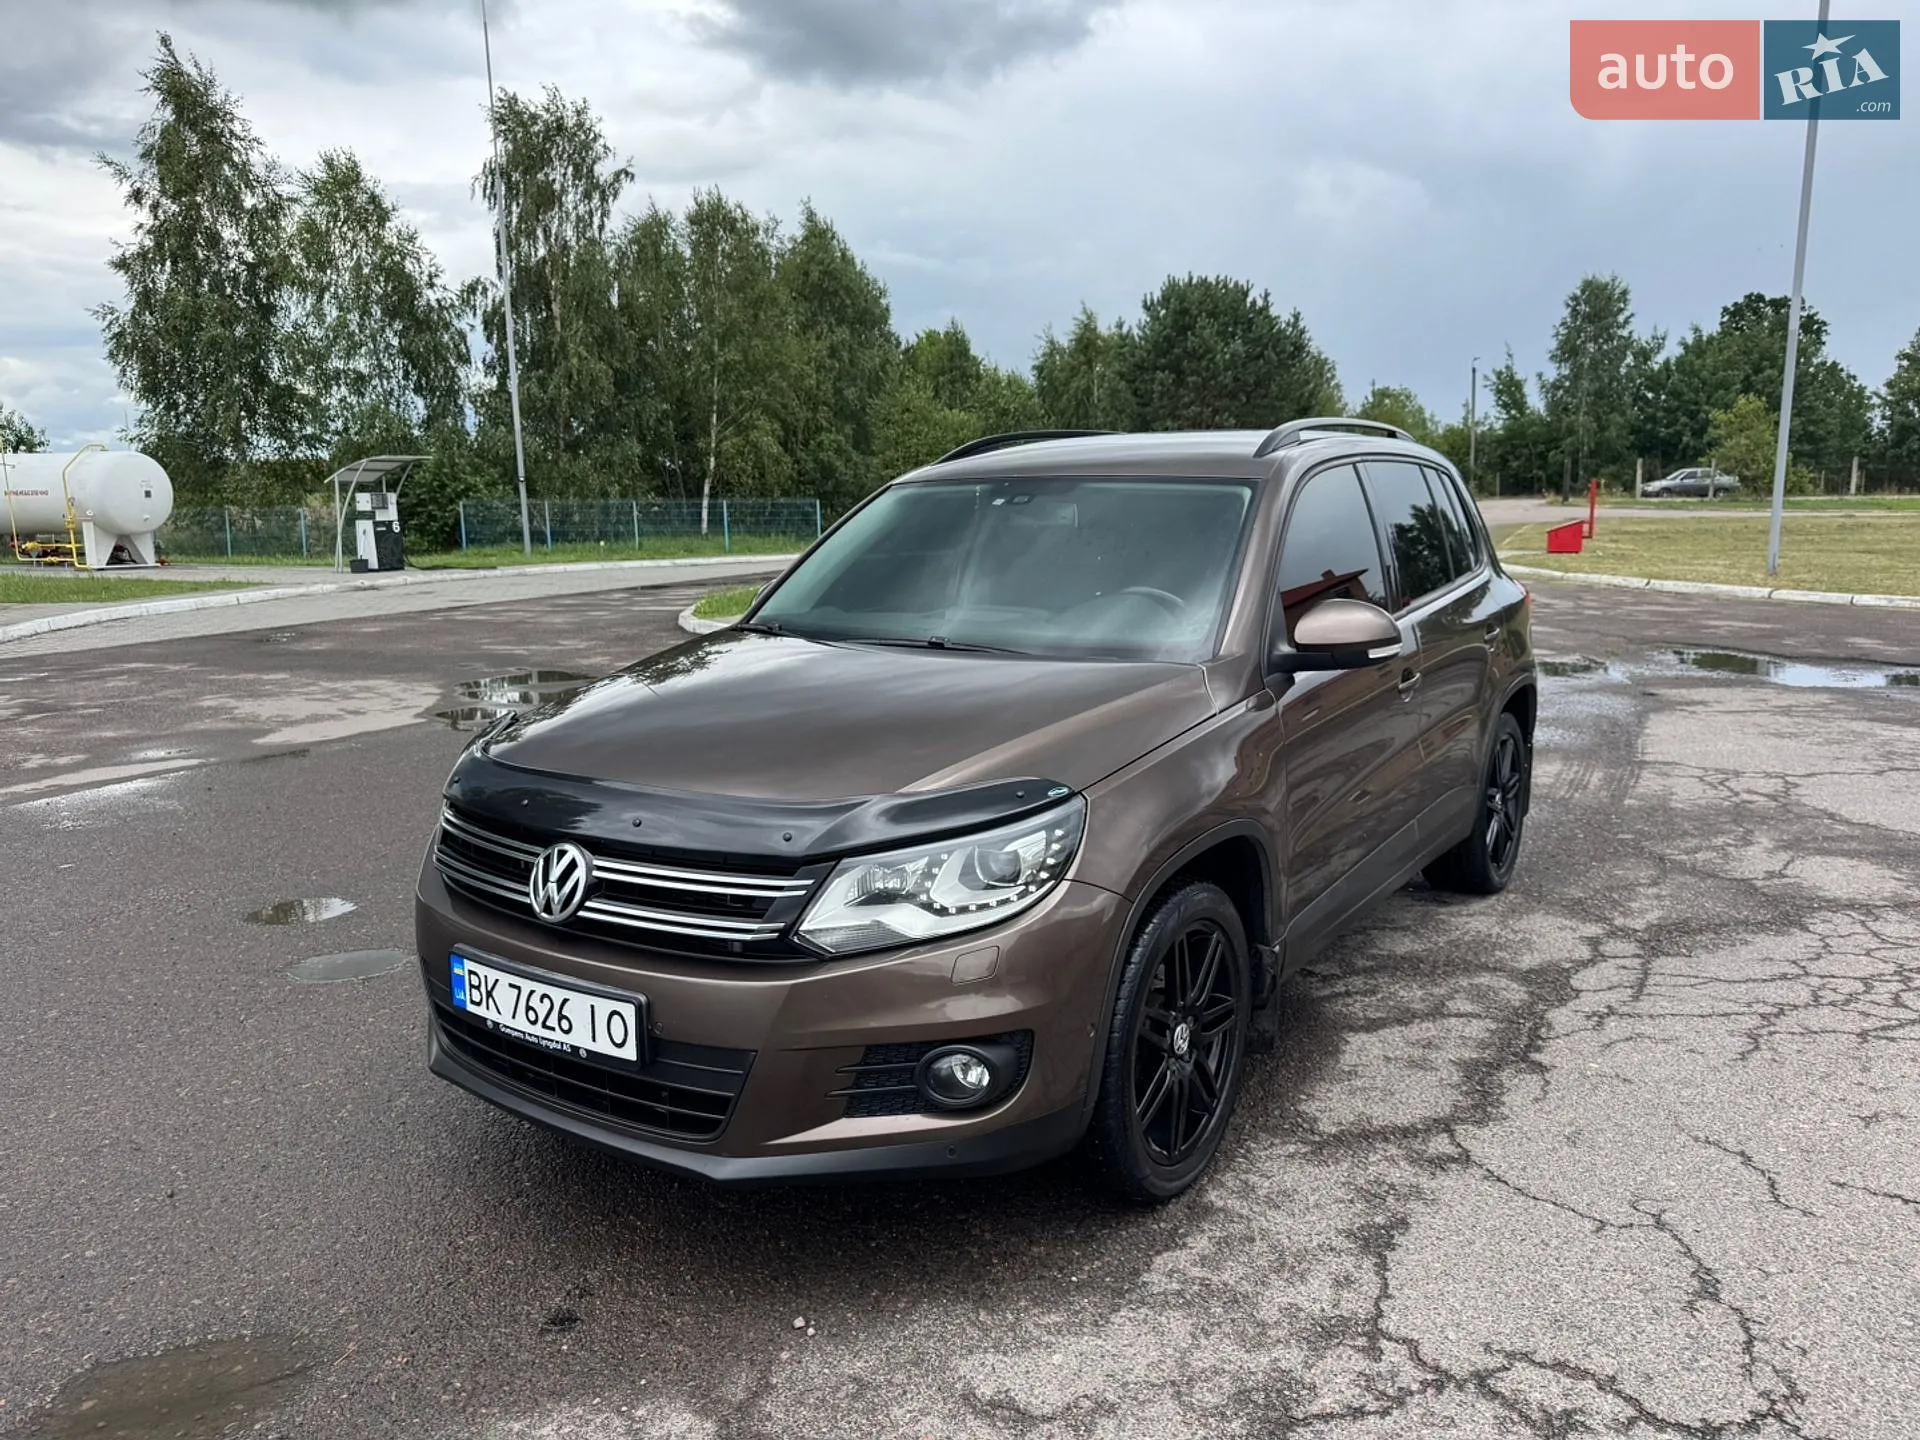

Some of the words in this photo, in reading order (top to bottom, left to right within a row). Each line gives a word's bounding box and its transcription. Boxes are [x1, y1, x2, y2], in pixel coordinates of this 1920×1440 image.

[392, 521, 400, 533] 6
[531, 843, 589, 922] VW
[468, 969, 502, 1015] BK
[508, 983, 573, 1034] 7626
[590, 1004, 628, 1049] IO
